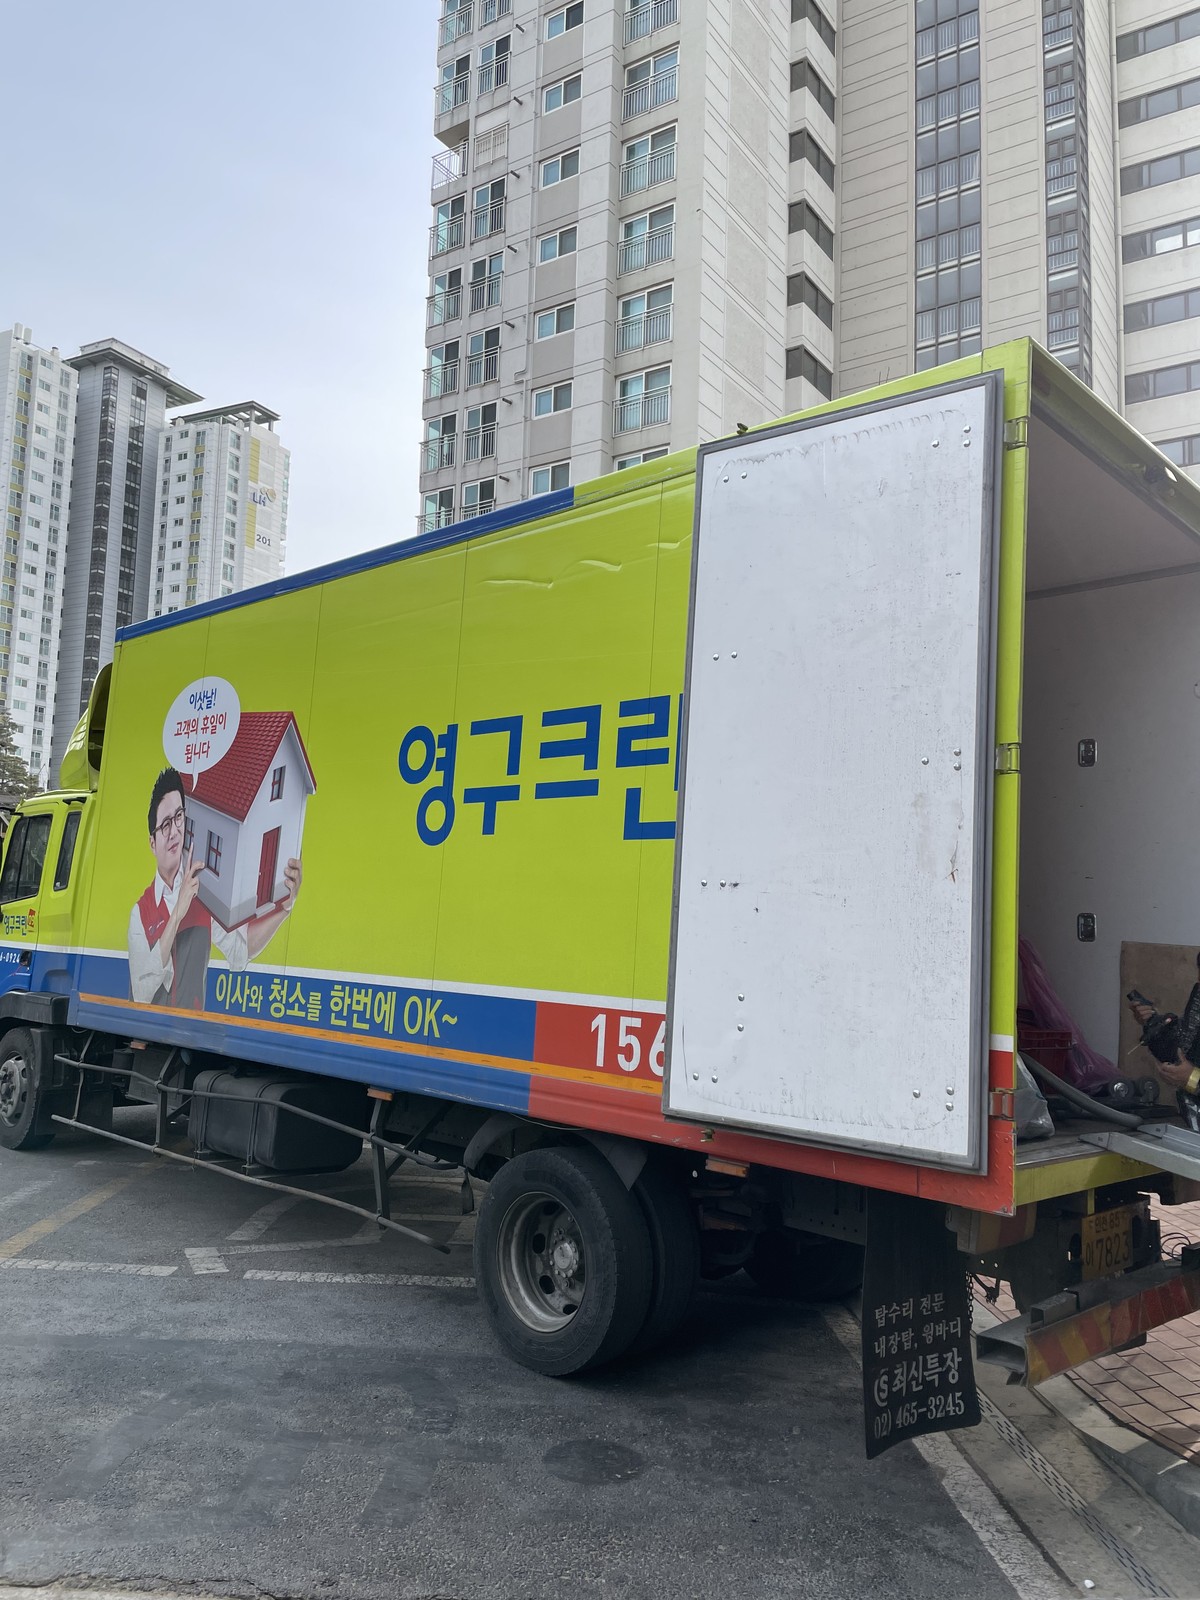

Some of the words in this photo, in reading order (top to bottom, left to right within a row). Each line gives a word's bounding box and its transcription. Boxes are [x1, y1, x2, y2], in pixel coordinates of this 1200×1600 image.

[256, 534, 271, 547] 201
[189, 688, 217, 711] 이삿날!
[174, 718, 199, 739] 고객의
[201, 712, 227, 735] 휴일이
[184, 741, 211, 764] 됩니다
[398, 693, 684, 846] 영구크린
[216, 973, 263, 1013] 이사와
[269, 978, 322, 1022] 청소를
[330, 984, 397, 1035] 한번에
[590, 1013, 666, 1077] 156
[874, 1298, 914, 1328] 탑수리
[920, 1292, 946, 1316] 전문
[874, 1328, 918, 1359] 내장탑,
[922, 1317, 963, 1344] 윙바디
[892, 1347, 963, 1397] 최신특장
